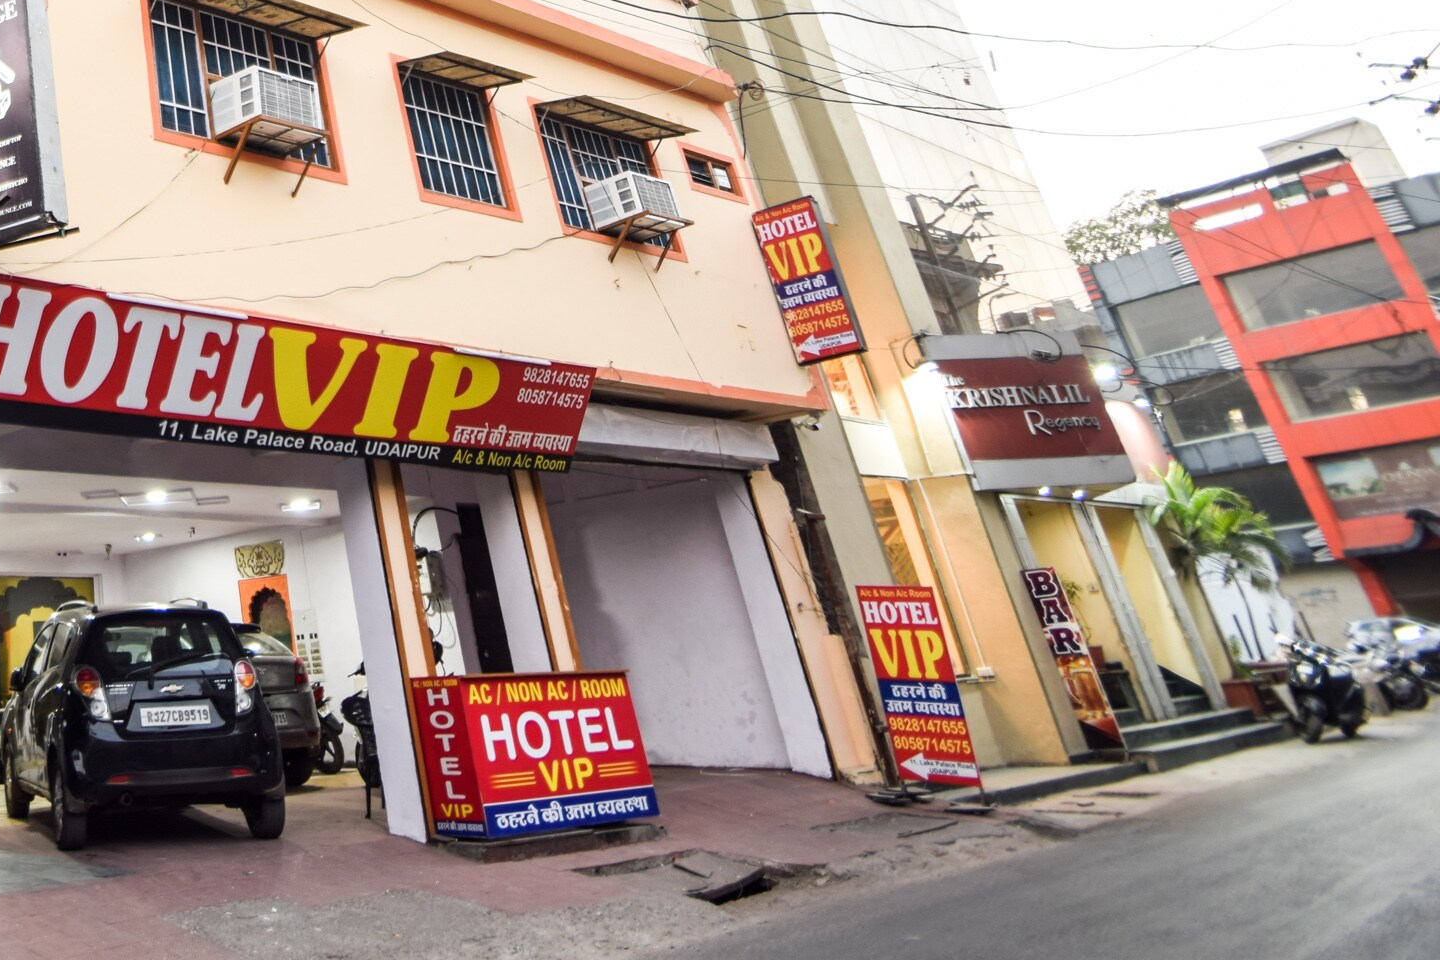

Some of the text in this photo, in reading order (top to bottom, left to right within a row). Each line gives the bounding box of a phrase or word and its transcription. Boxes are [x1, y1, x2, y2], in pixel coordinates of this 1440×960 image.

[755, 211, 817, 242] HOTEL
[765, 233, 823, 281] VIP
[784, 274, 827, 295] ठहरने की
[785, 300, 845, 323] 9828147655
[791, 313, 850, 337] 8058714575
[266, 326, 501, 444] VIP
[522, 366, 591, 389] 9828147655
[516, 388, 585, 410] 8058714575
[452, 422, 490, 445] ठहरने
[490, 424, 507, 447] की
[1023, 409, 1102, 436] Regency
[158, 420, 441, 461] 11, Lake Palace Road, UDAIPUR
[452, 449, 567, 472] A/c & Non A/c Room
[880, 589, 895, 598] Non
[908, 589, 932, 598] Room
[861, 601, 939, 625] HOTEL
[1024, 569, 1084, 656] BAR
[869, 628, 945, 680] VIP
[469, 683, 493, 705] AC
[505, 681, 543, 703] NON
[547, 680, 569, 702] AC
[580, 678, 627, 699] ROOM
[890, 682, 947, 700] ठहरने की
[146, 709, 210, 724] RJ27CB9519
[884, 699, 961, 716] उत्तम व्यवस्था
[480, 706, 635, 762] HOTEL
[888, 716, 966, 735] 9828147655
[426, 688, 466, 800] HOTEL
[893, 735, 972, 755] 8058714575
[538, 757, 594, 792] VIP
[440, 803, 474, 818] VIP
[495, 803, 540, 829] ठहरने
[540, 800, 564, 823] की
[596, 795, 649, 816] व्यवस्था
